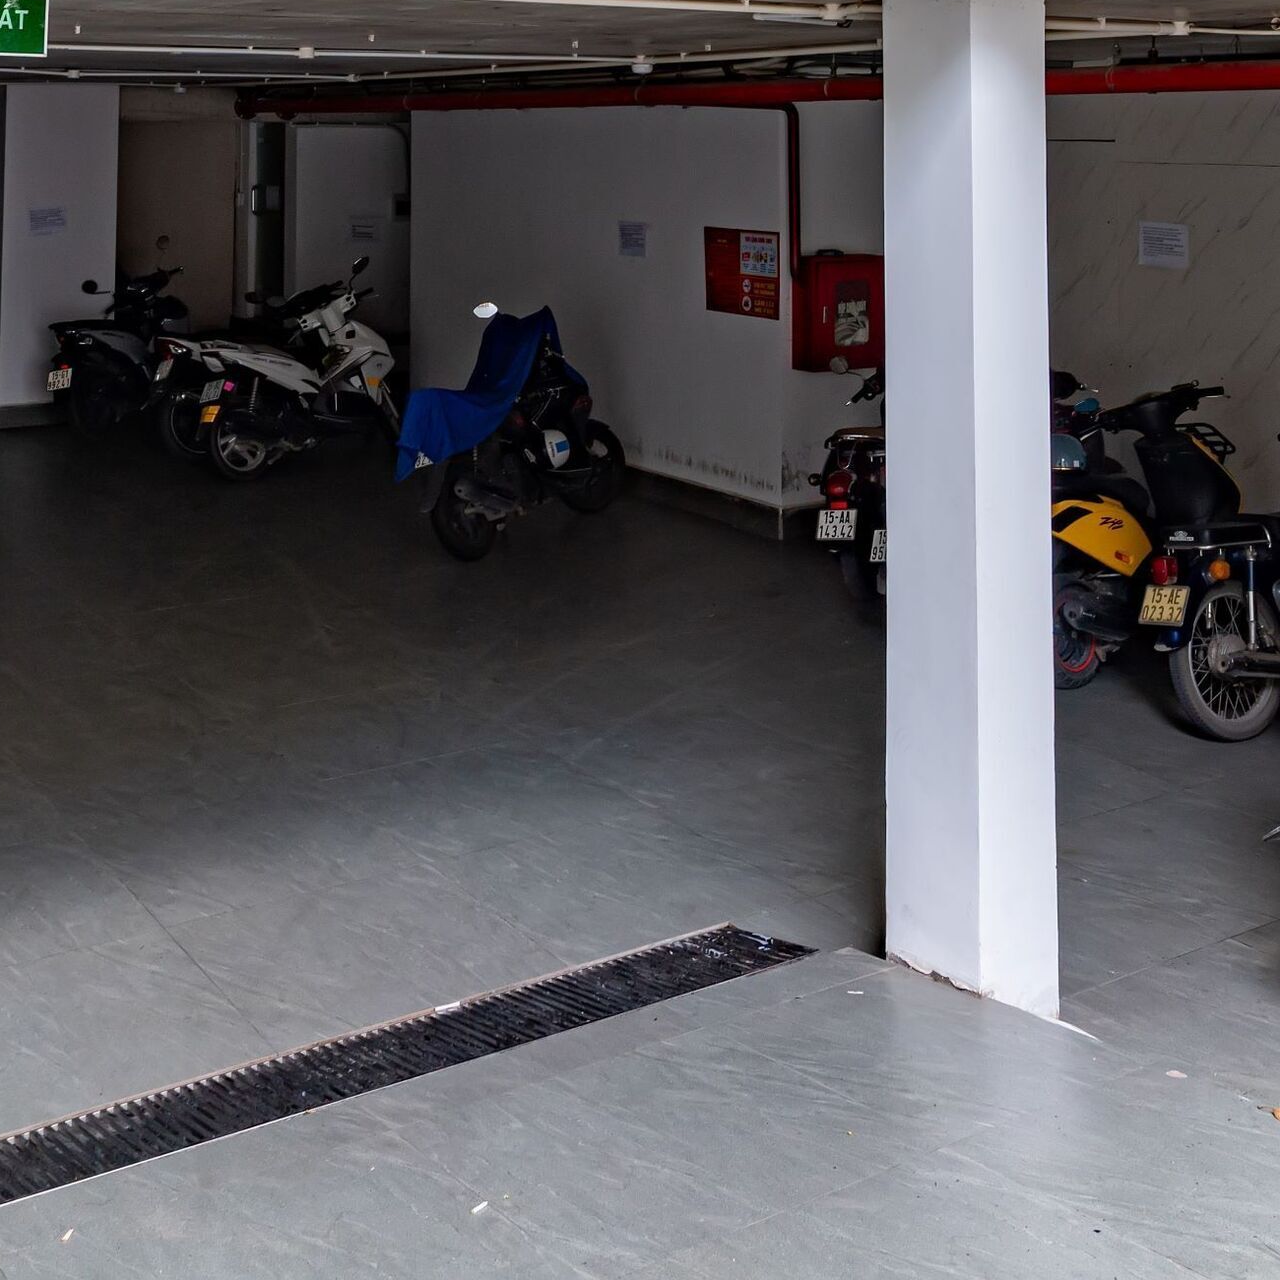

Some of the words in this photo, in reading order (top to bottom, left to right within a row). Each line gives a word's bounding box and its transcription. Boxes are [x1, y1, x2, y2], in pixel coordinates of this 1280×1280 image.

[824, 511, 850, 524] 15-AA
[820, 525, 853, 538] 143.42
[1151, 588, 1182, 605] 15-AE
